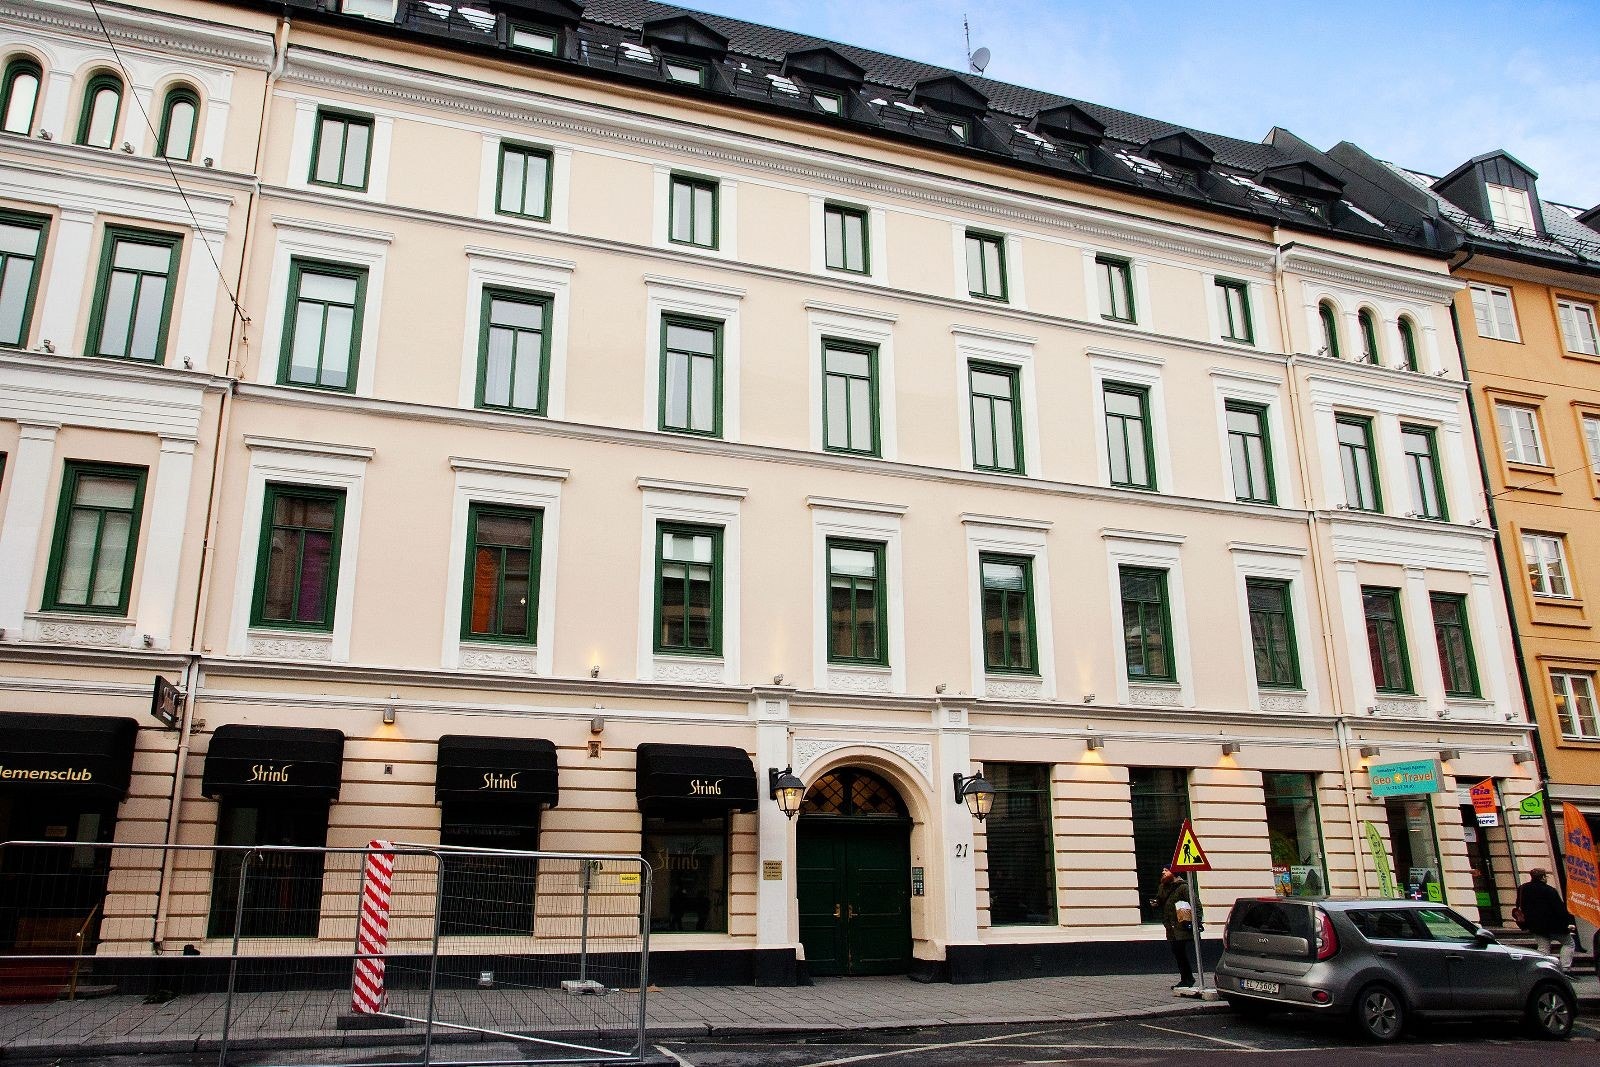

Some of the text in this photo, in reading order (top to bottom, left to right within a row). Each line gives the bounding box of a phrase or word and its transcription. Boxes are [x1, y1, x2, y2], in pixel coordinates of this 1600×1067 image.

[1372, 769, 1433, 785] Geo Travel
[955, 843, 968, 858] 21
